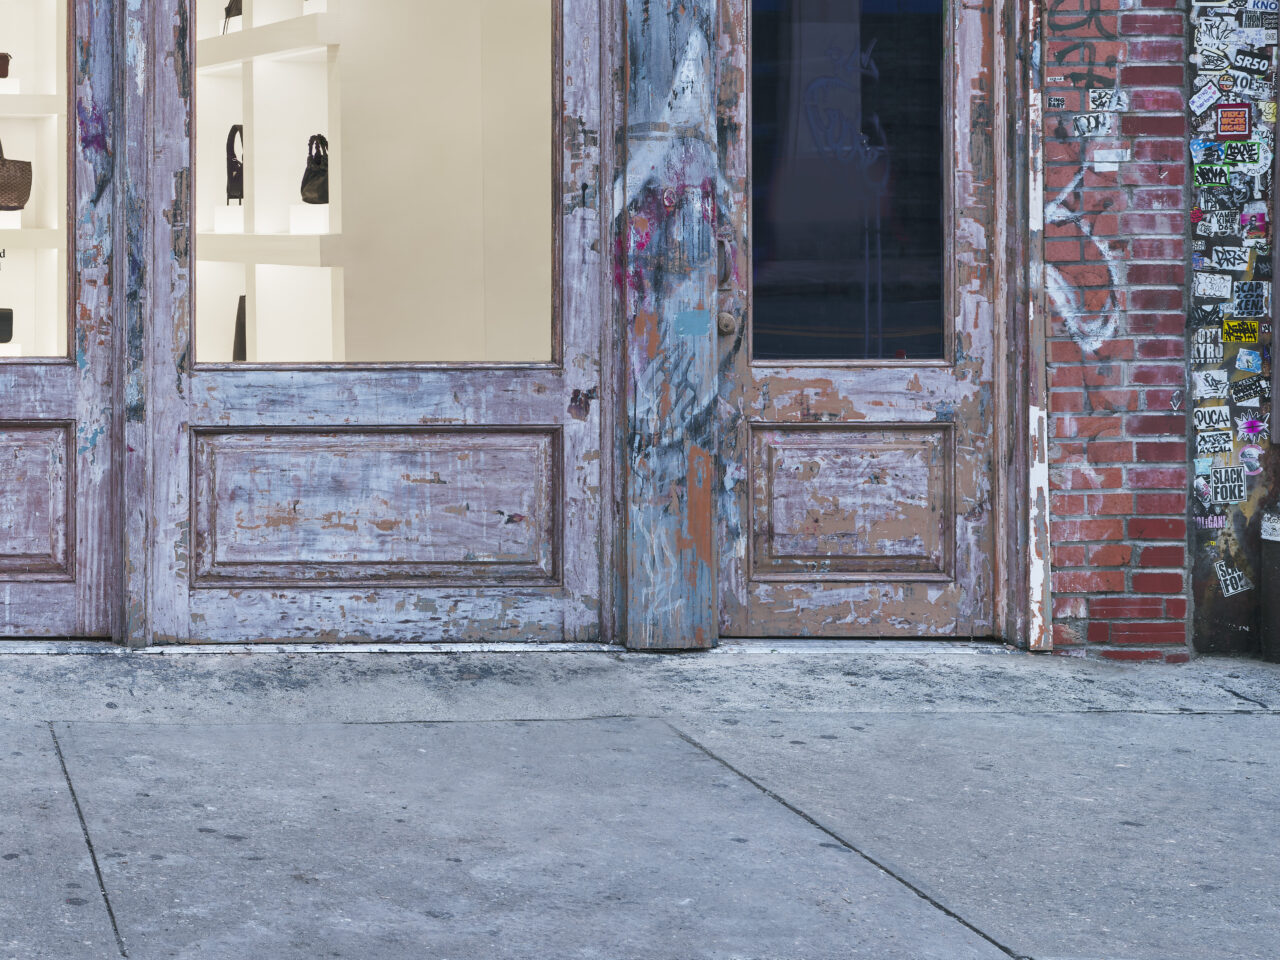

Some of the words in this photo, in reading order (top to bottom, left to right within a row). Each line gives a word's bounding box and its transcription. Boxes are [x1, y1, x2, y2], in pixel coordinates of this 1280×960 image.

[1235, 55, 1269, 71] SR50
[1213, 469, 1243, 485] SLACK
[1214, 484, 1244, 500] FOKE
